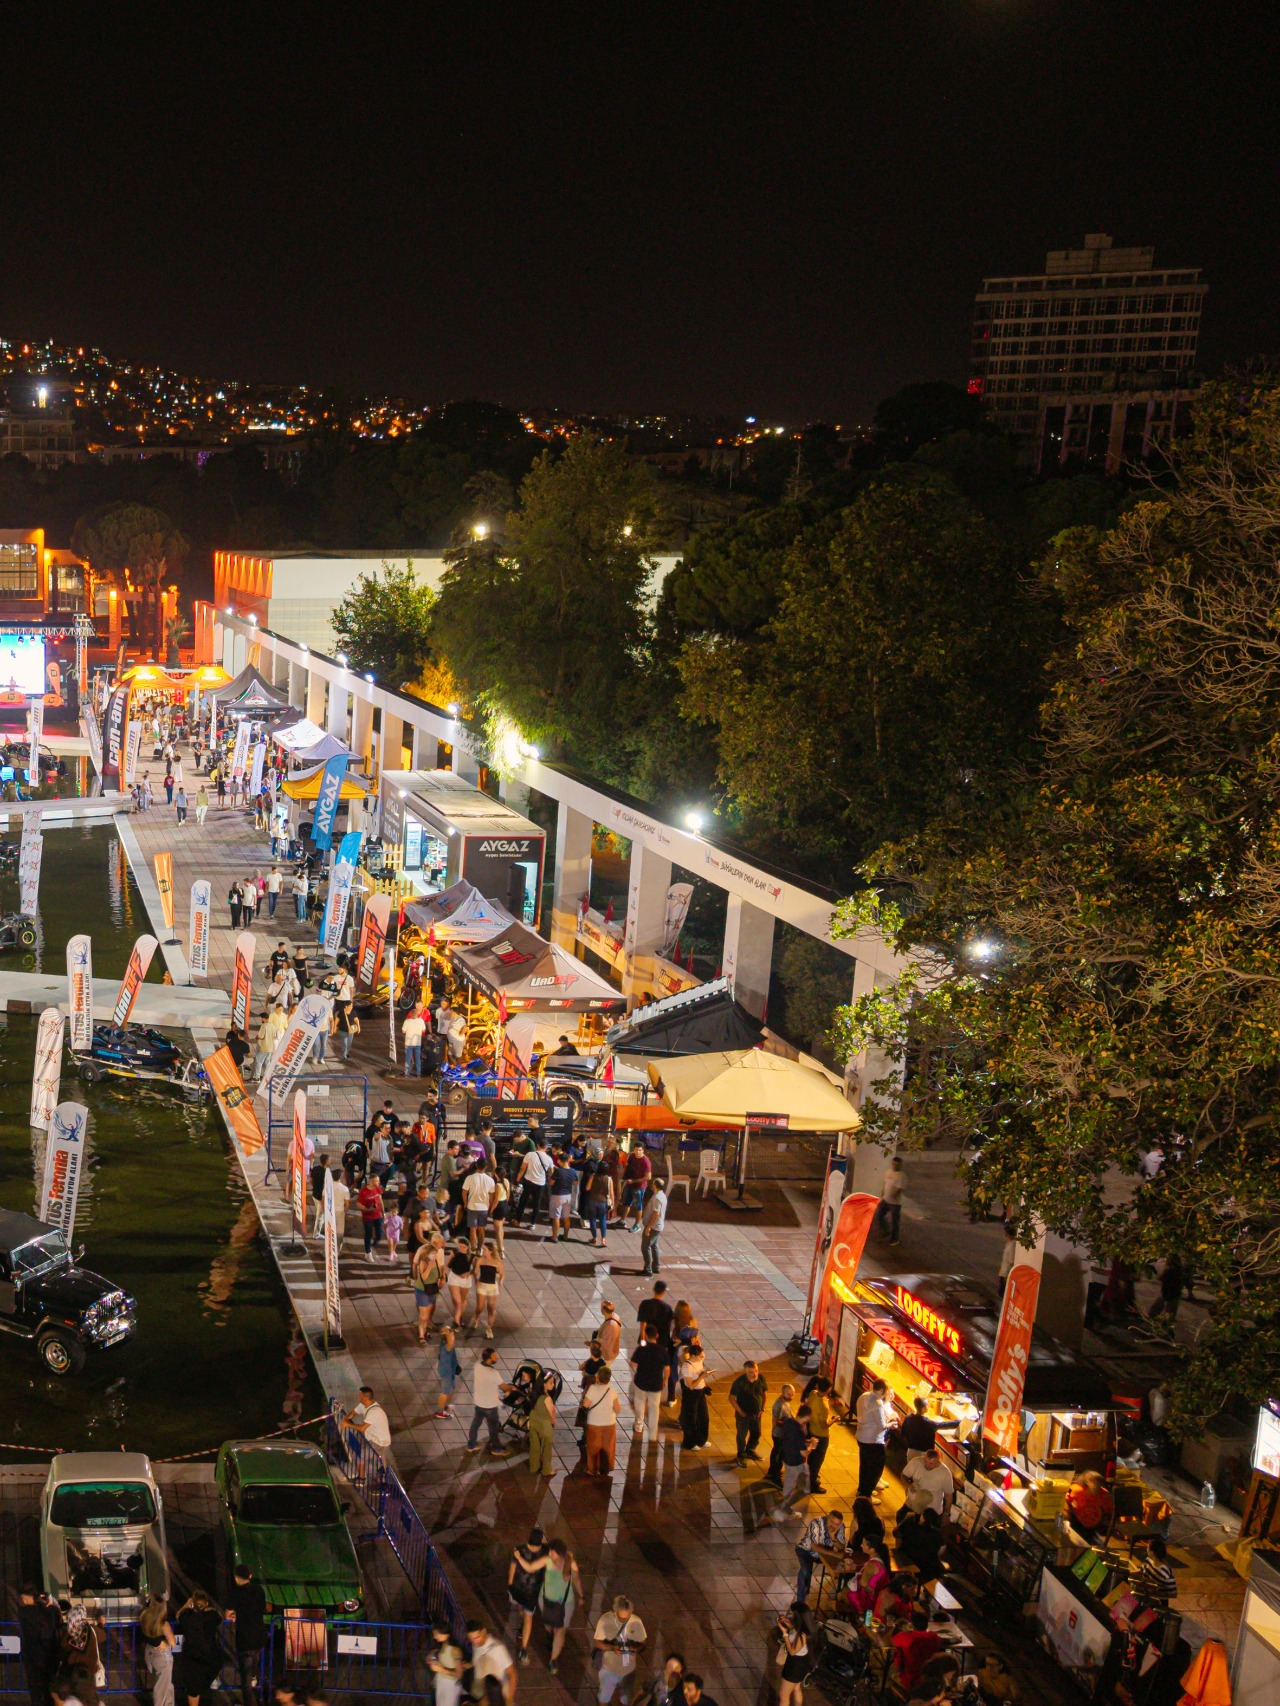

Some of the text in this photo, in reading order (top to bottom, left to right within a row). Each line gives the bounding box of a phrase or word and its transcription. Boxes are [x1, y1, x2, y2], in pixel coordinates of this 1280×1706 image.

[316, 773, 339, 834] AYGAZ
[479, 840, 530, 852] AYGAZ
[73, 973, 84, 1012] Feronia
[277, 1028, 306, 1068] Feronia
[49, 1150, 69, 1200] Feronia
[897, 1286, 961, 1353] LOOFFY'S
[984, 1343, 1027, 1445] Looffy's
